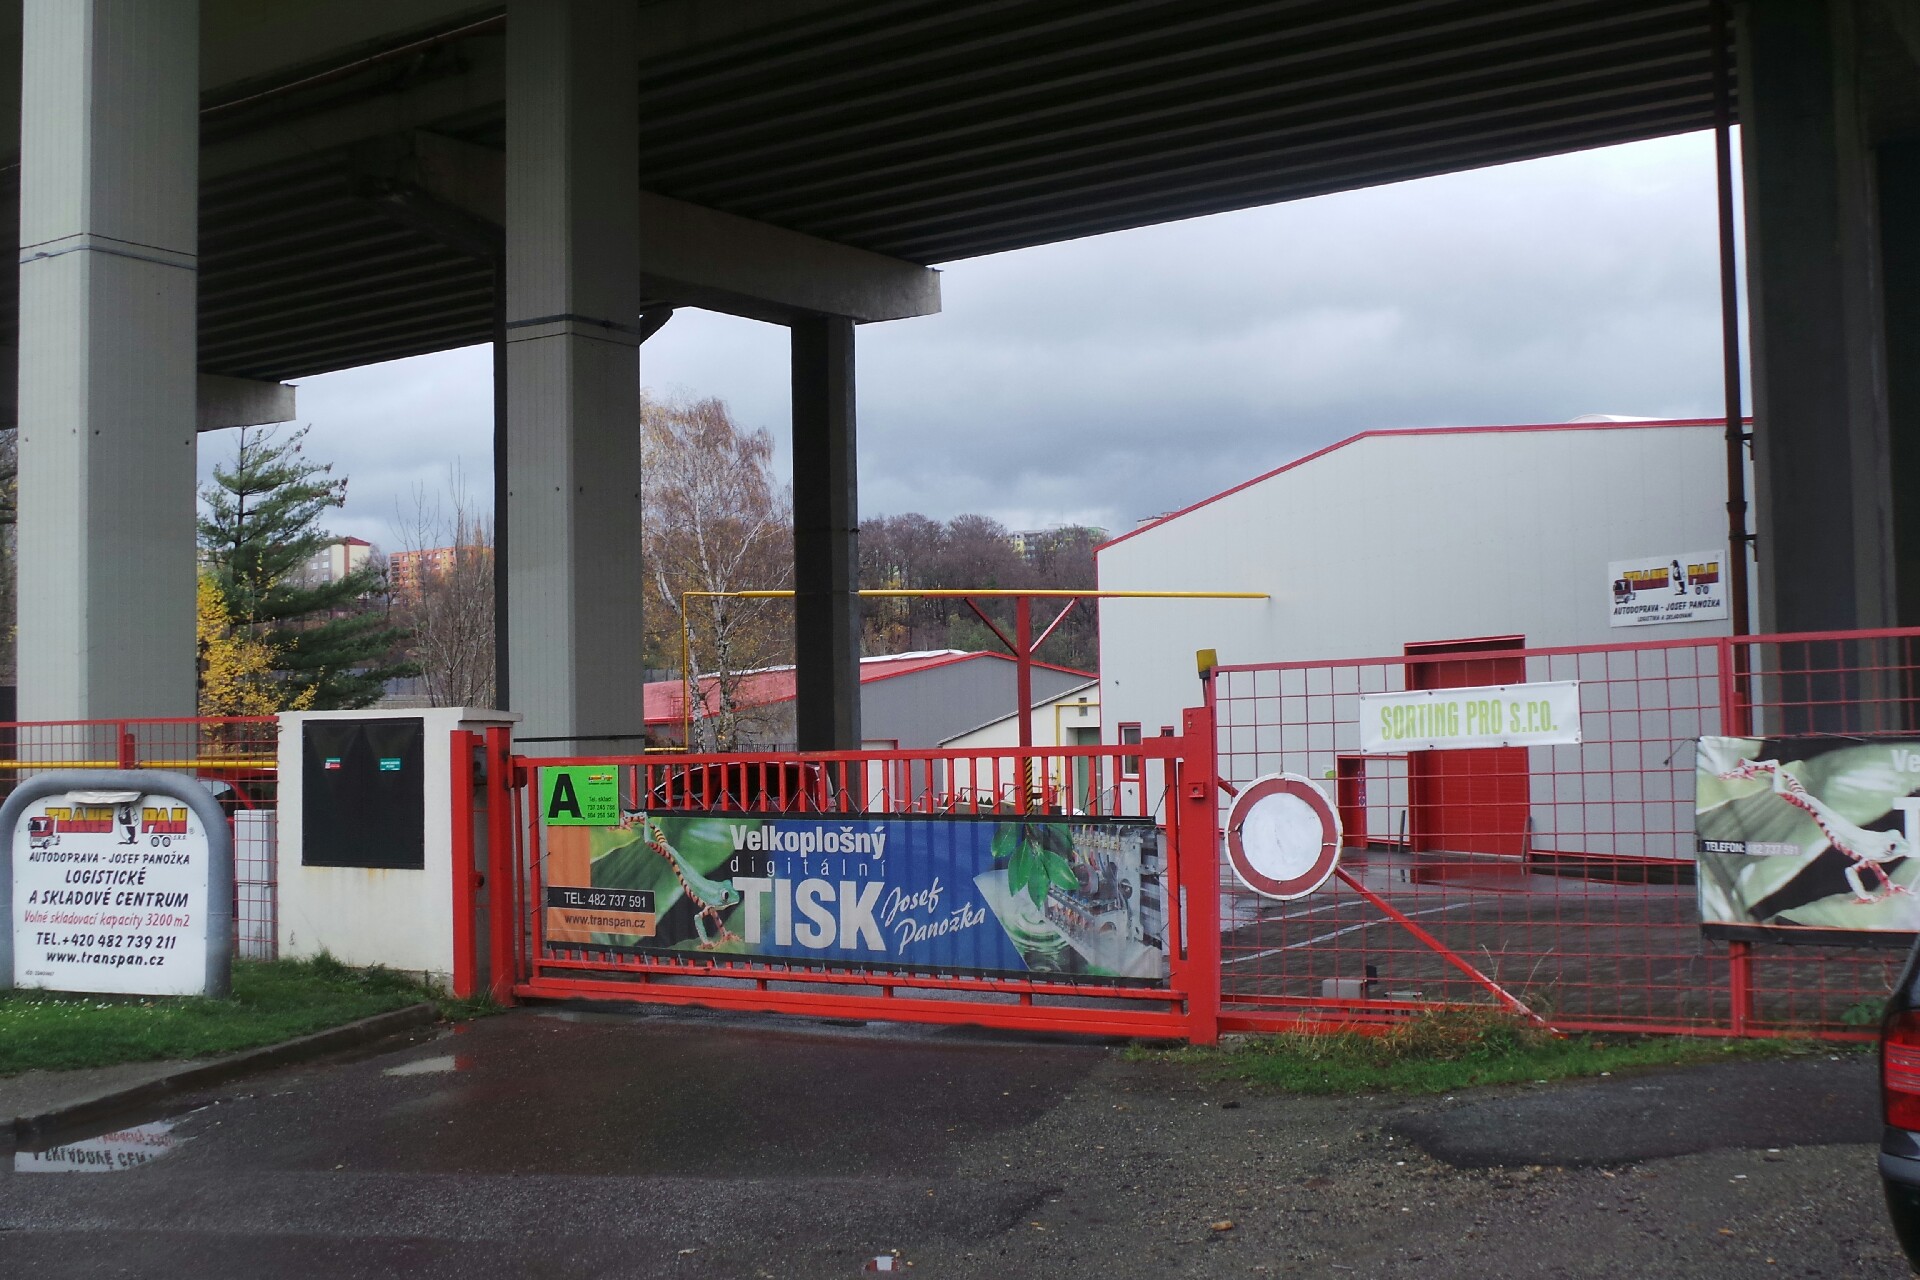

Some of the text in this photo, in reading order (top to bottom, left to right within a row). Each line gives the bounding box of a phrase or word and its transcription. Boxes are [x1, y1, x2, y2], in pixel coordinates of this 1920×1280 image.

[1613, 604, 1659, 615] AUTODOPRAVA
[1665, 601, 1686, 611] JOSEF
[1689, 597, 1720, 609] PANOŽKA
[1380, 701, 1459, 740] SORTING
[1466, 699, 1503, 735] PRO
[548, 773, 583, 818] A
[142, 807, 188, 834] PAN
[729, 824, 886, 859] Velkoplošný
[1705, 841, 1745, 853] TELEFON:
[29, 851, 99, 863] AUTODOPRAVA
[109, 853, 139, 864] JOSEF
[143, 851, 190, 866] PANOŽKA
[730, 856, 886, 877] digitální
[65, 867, 146, 885] LOGISTICKÉ
[29, 887, 189, 908] A SKLADOVÉ CENTRUM
[564, 891, 646, 908] TEL: 482 737 591
[880, 876, 944, 927] Josef
[24, 910, 190, 930] Volné skladovací kapacity 3200 m2
[564, 914, 646, 929] www.transpan.cz
[732, 877, 887, 951] TISK
[894, 901, 986, 955] Panožka
[36, 932, 177, 950] TEL.+420 482 739 211
[46, 951, 165, 969] www.transpan.cz
